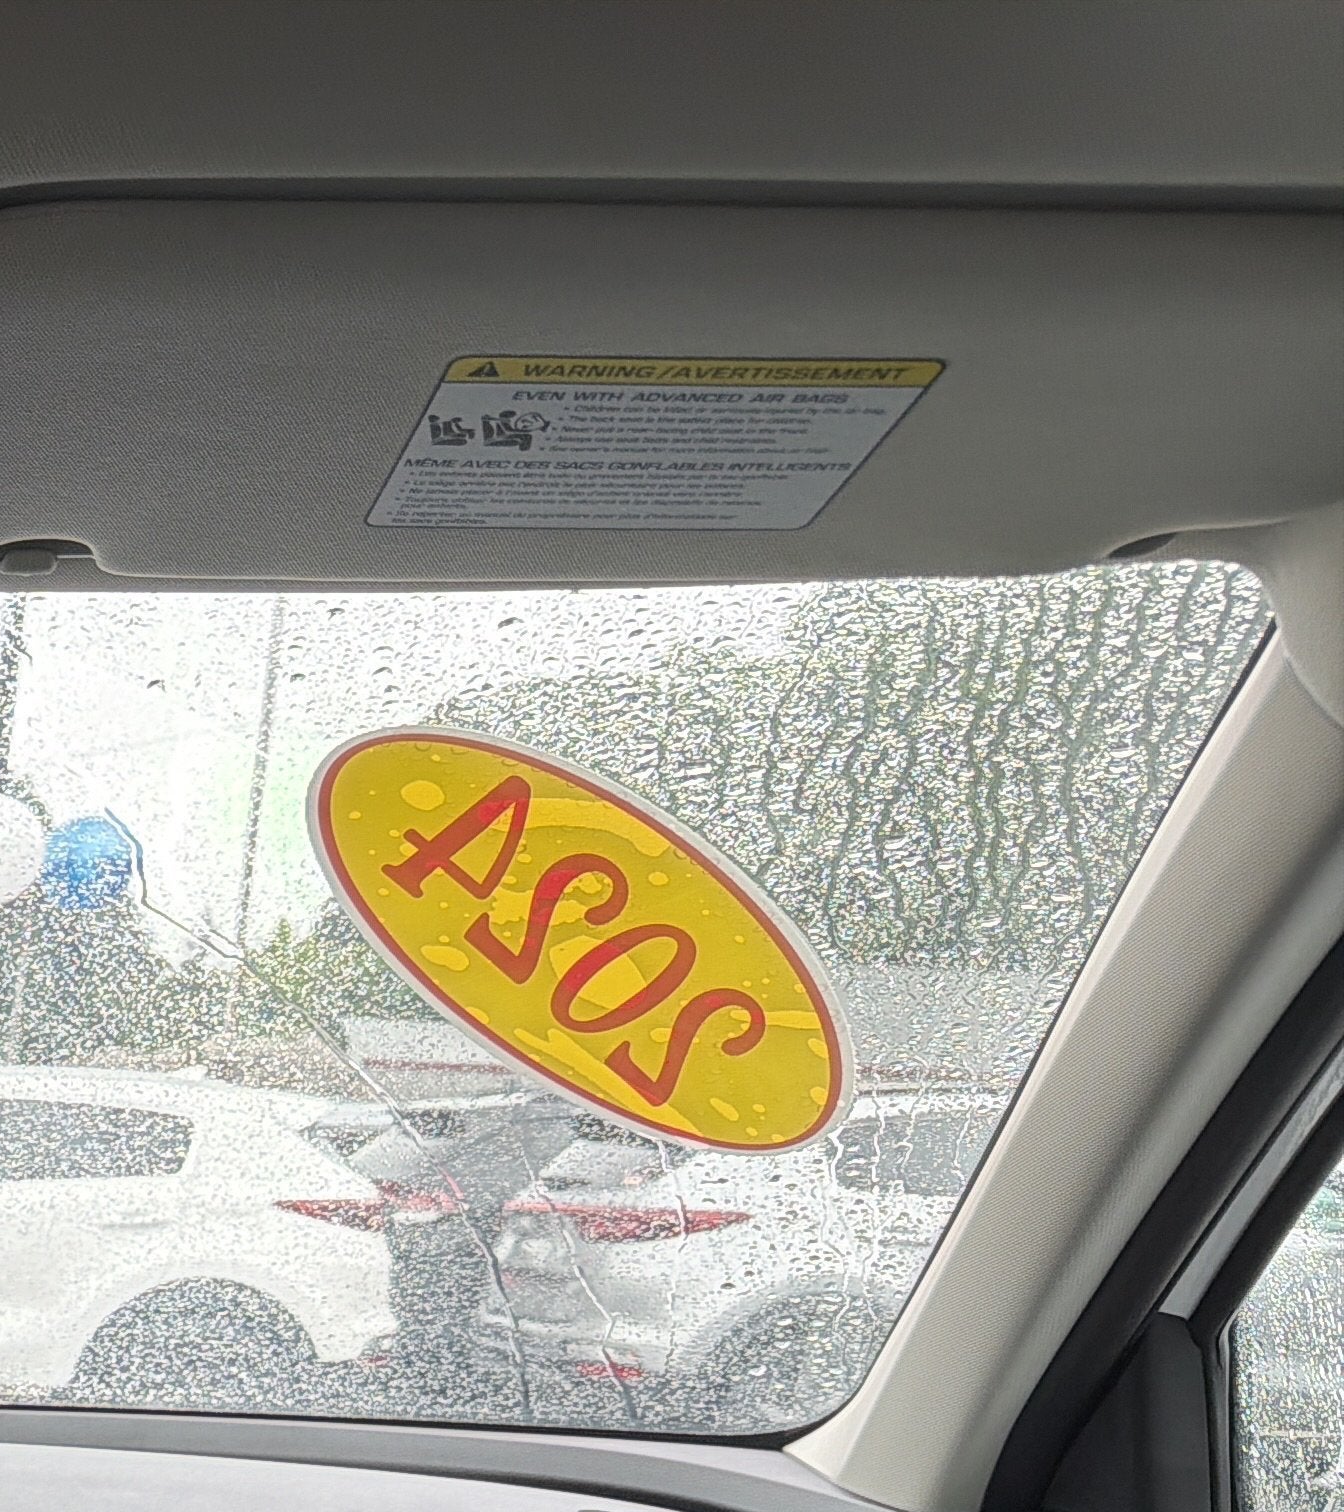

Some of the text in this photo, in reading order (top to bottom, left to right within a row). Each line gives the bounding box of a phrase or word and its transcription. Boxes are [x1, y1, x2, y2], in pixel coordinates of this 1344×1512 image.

[512, 391, 849, 404] EVEN WITH ADVANCED AIR BAGS
[461, 460, 511, 469] AVEC
[513, 460, 550, 469] DES
[553, 461, 604, 470] SACS
[608, 461, 724, 471] GONFLABLES
[727, 462, 852, 472] INTELLIGENTS
